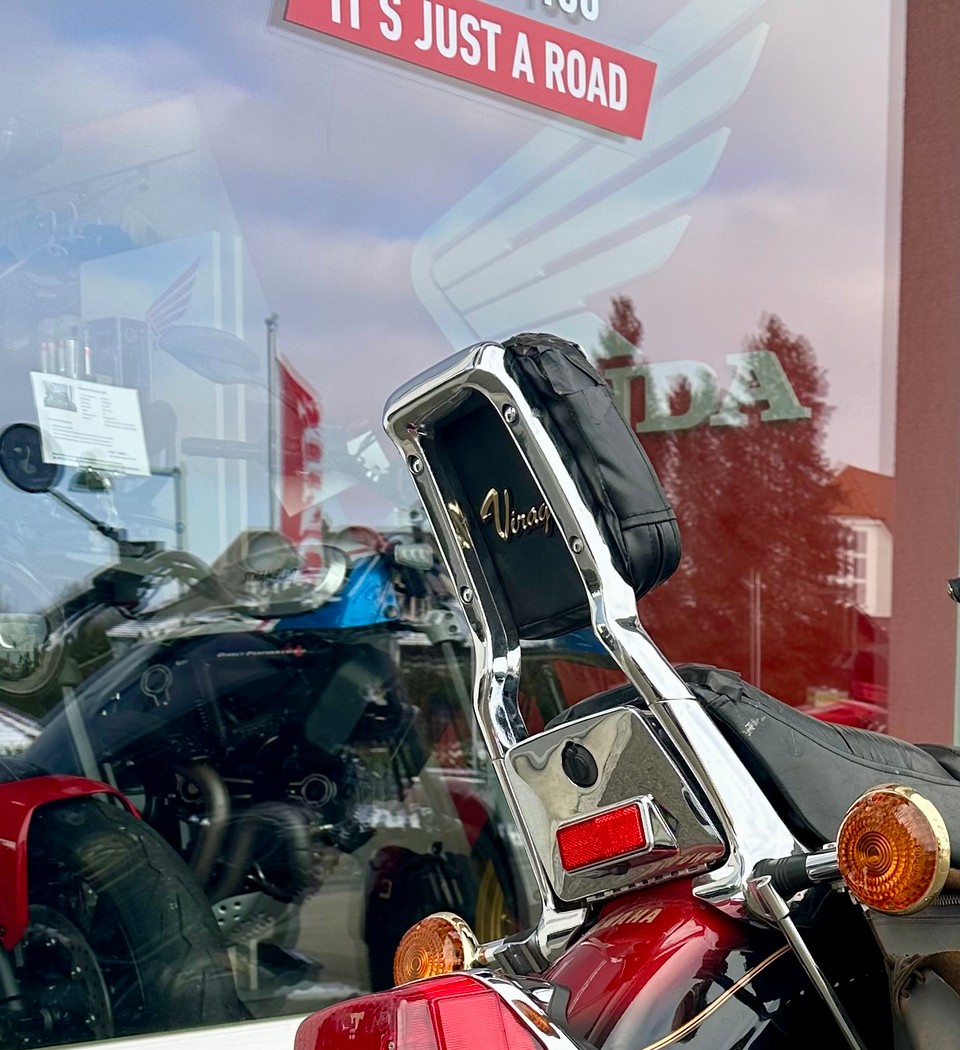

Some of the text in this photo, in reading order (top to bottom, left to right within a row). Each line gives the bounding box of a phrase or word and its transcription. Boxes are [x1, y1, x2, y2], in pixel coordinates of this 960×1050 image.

[414, 0, 501, 72] JUST
[511, 31, 535, 84] A
[545, 40, 628, 112] ROAD
[480, 487, 550, 539] Virag
